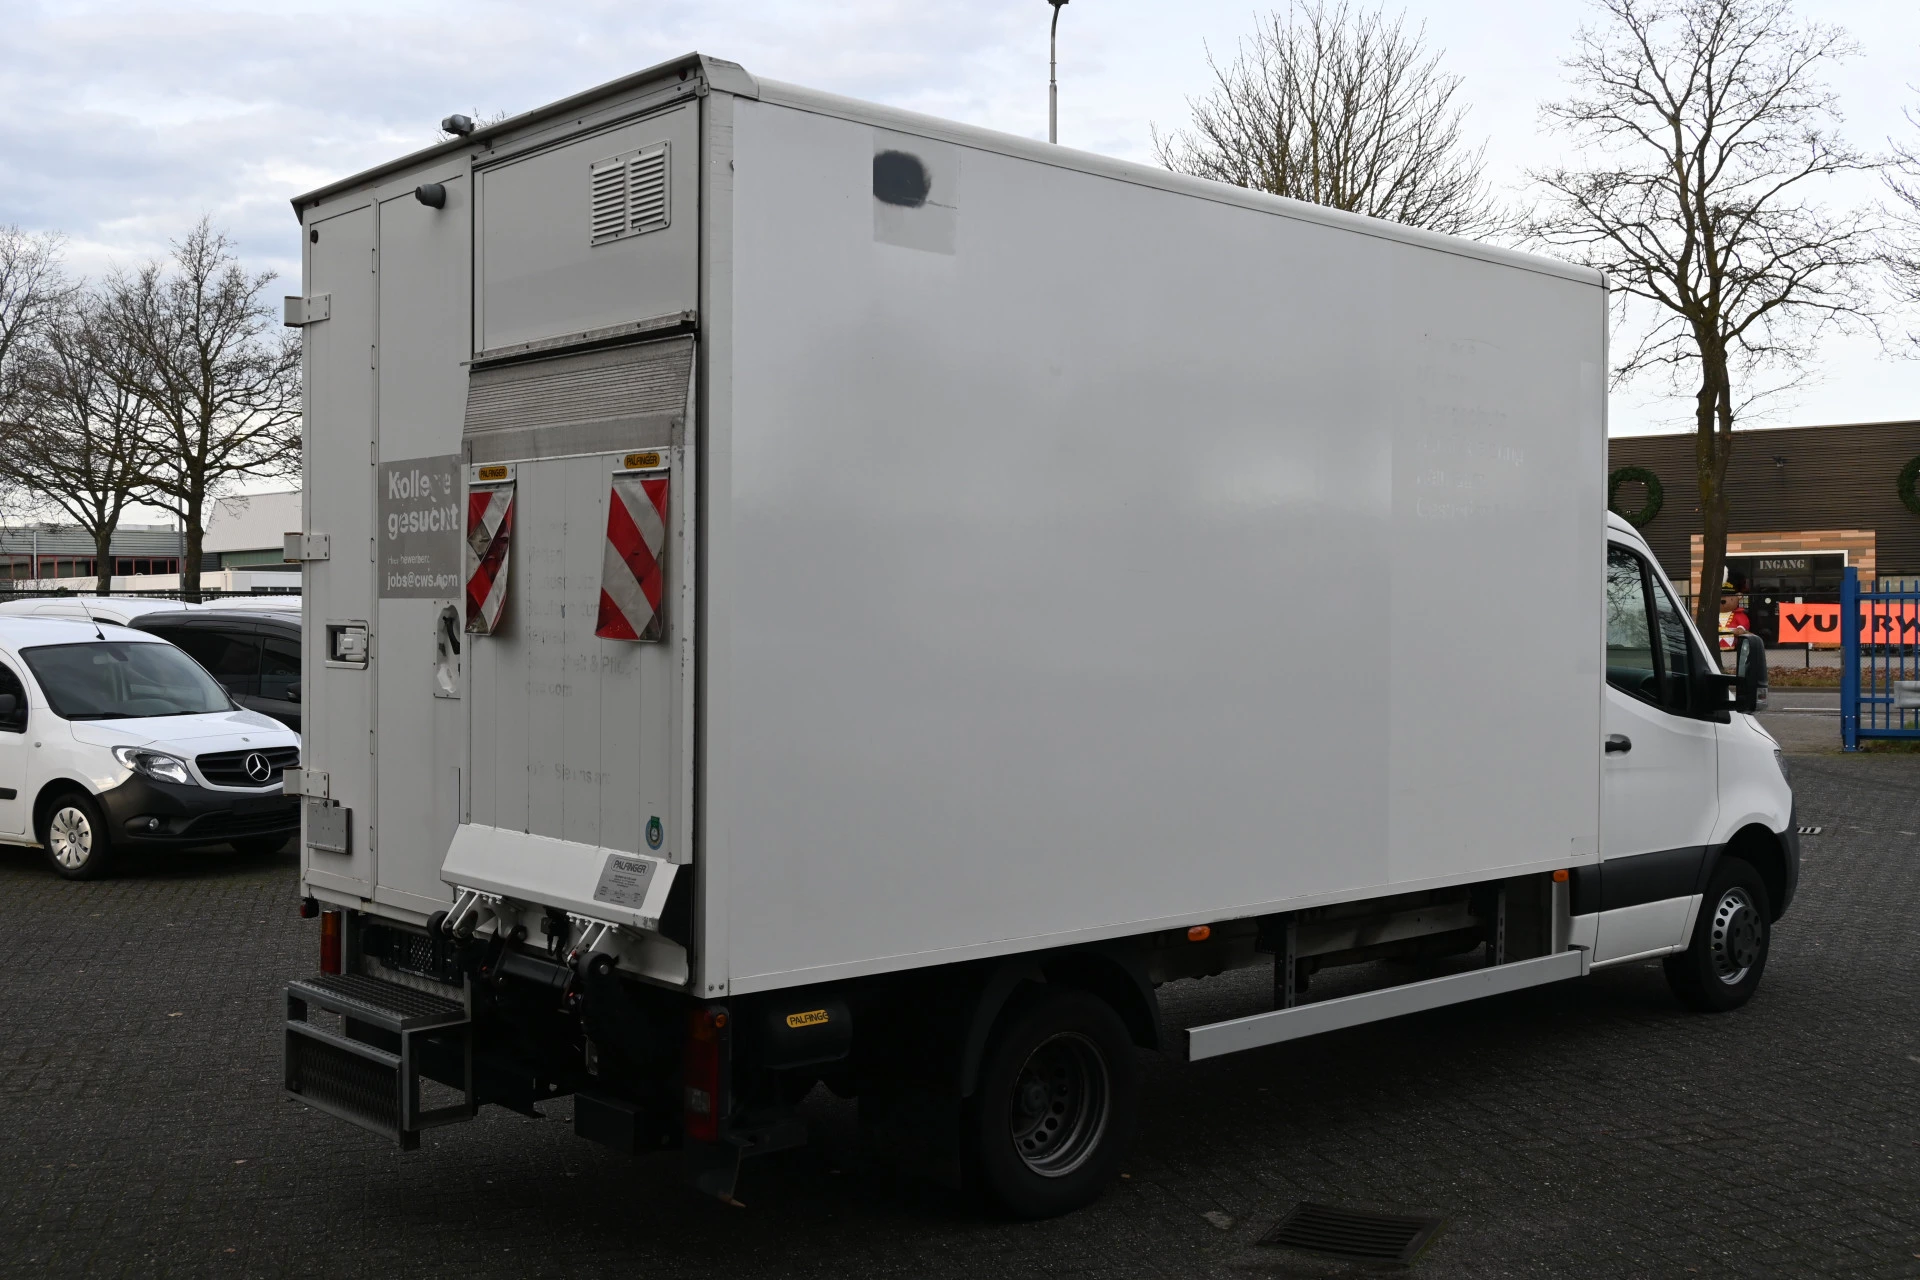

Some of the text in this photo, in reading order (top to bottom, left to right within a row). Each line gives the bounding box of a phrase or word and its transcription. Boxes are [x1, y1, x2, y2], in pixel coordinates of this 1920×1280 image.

[626, 453, 658, 467] PALFINGER
[480, 468, 506, 479] PALFINGER
[388, 503, 459, 540] gesucht
[1760, 559, 1805, 570] INGANG
[612, 859, 647, 874] PALFINGER
